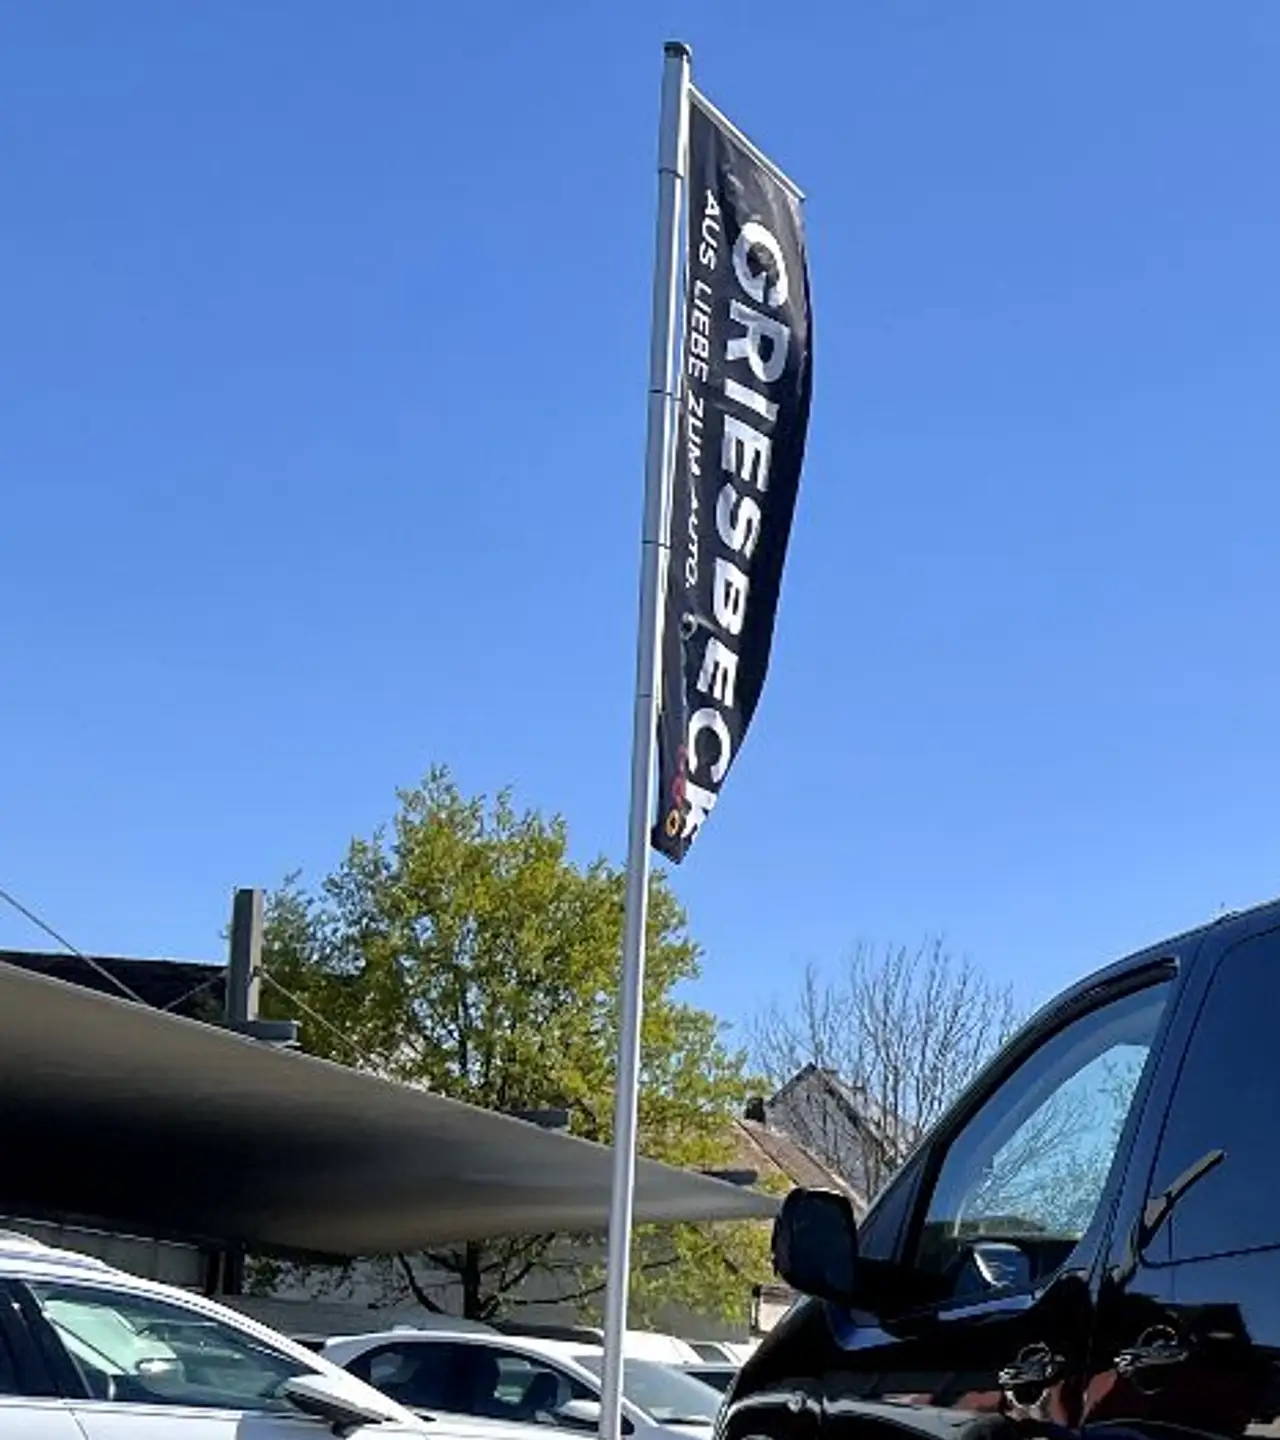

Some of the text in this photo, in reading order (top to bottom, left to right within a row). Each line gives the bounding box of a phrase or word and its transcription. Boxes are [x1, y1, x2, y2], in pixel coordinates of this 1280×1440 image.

[699, 189, 721, 270] AUS
[688, 279, 713, 383] LIEBE
[686, 388, 705, 477] ZUM
[680, 221, 791, 840] GRIESBECK
